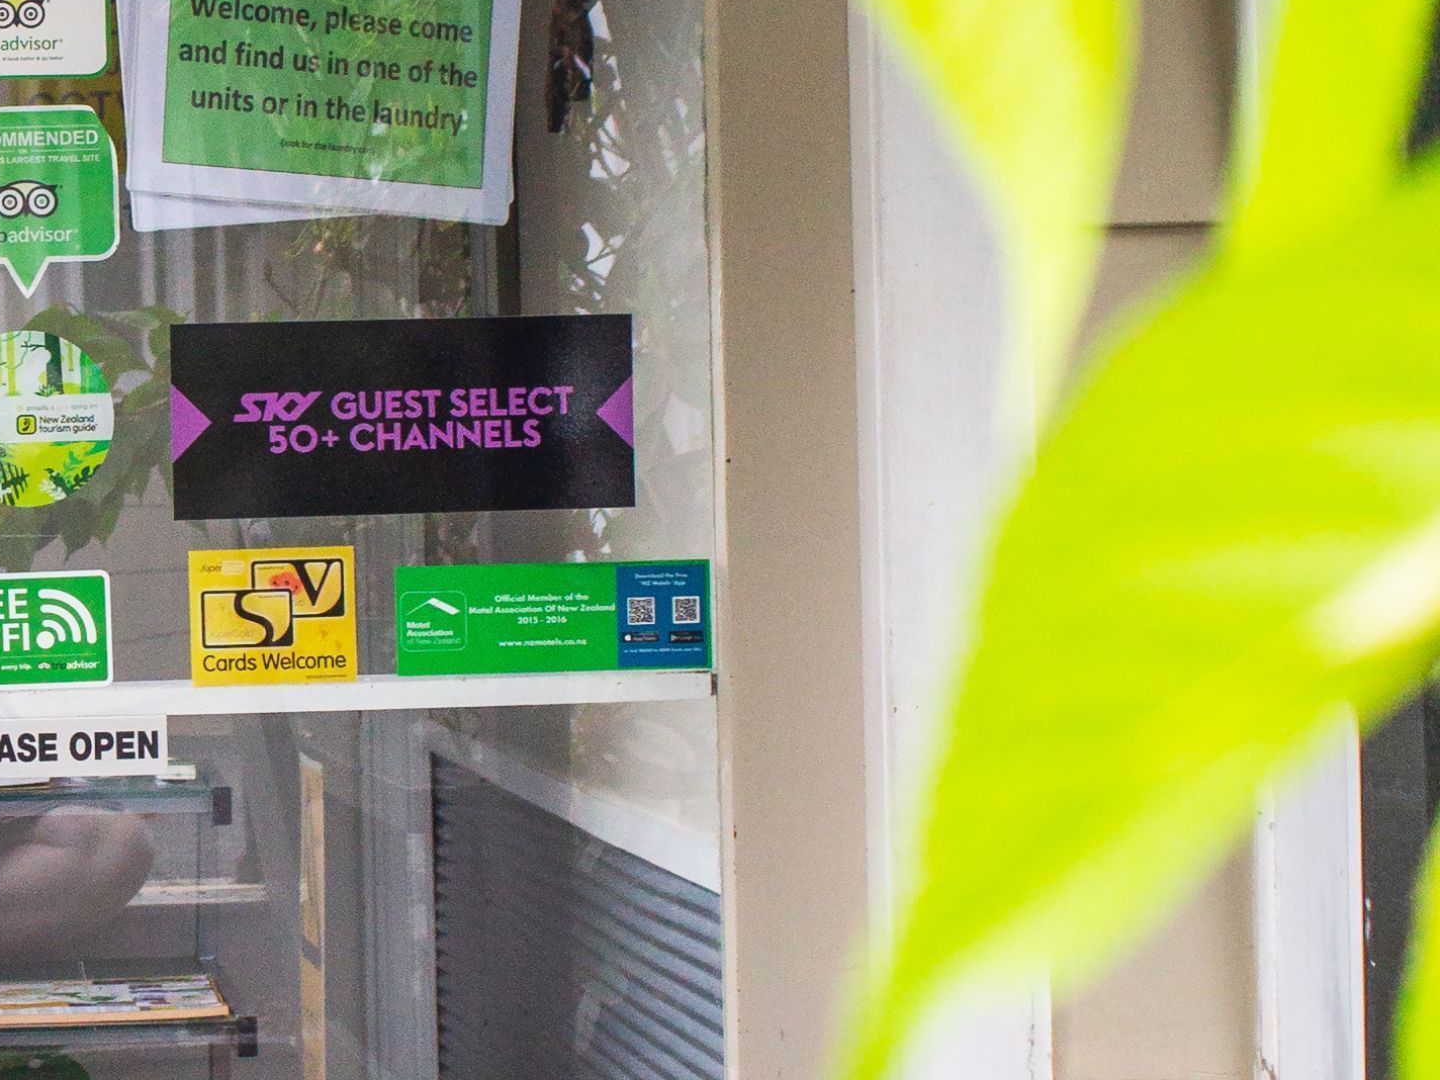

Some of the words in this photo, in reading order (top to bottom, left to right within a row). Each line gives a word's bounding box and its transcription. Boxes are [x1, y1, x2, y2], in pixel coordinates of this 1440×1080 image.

[325, 6, 402, 35] please
[409, 20, 473, 43] come
[179, 40, 227, 64] and
[235, 41, 284, 70] find
[292, 53, 319, 73] us
[327, 51, 349, 75] in
[357, 59, 401, 80] one
[408, 59, 434, 83] of
[439, 62, 478, 88] the
[191, 86, 254, 112] units
[262, 96, 289, 115] or
[296, 93, 318, 118] in
[325, 96, 366, 122] the
[373, 99, 463, 136] laundry
[6, 156, 46, 164] LARGEST
[47, 155, 80, 163] TRAVEL
[82, 154, 100, 162] SITE
[232, 391, 324, 423] SKY
[330, 390, 442, 419] GUEST
[450, 386, 574, 417] SELECT
[39, 416, 59, 424] New
[60, 414, 95, 424] Zealand
[39, 424, 71, 433] tourism
[73, 424, 96, 434] guide
[268, 425, 335, 455] 50+
[349, 419, 541, 453] CHANNELS
[494, 593, 526, 602] Official
[527, 593, 562, 602] Member
[564, 592, 574, 601] of
[468, 606, 493, 614] Motel
[494, 605, 543, 614] Association
[544, 604, 556, 613] Of
[557, 604, 579, 612] New
[579, 603, 616, 612] Zealand
[517, 616, 539, 624] 2015
[545, 615, 568, 624] 2016
[52, 660, 97, 671] tripadvisor
[203, 653, 257, 672] Cards
[262, 651, 347, 670] Welcome
[69, 730, 159, 761] OPEN
